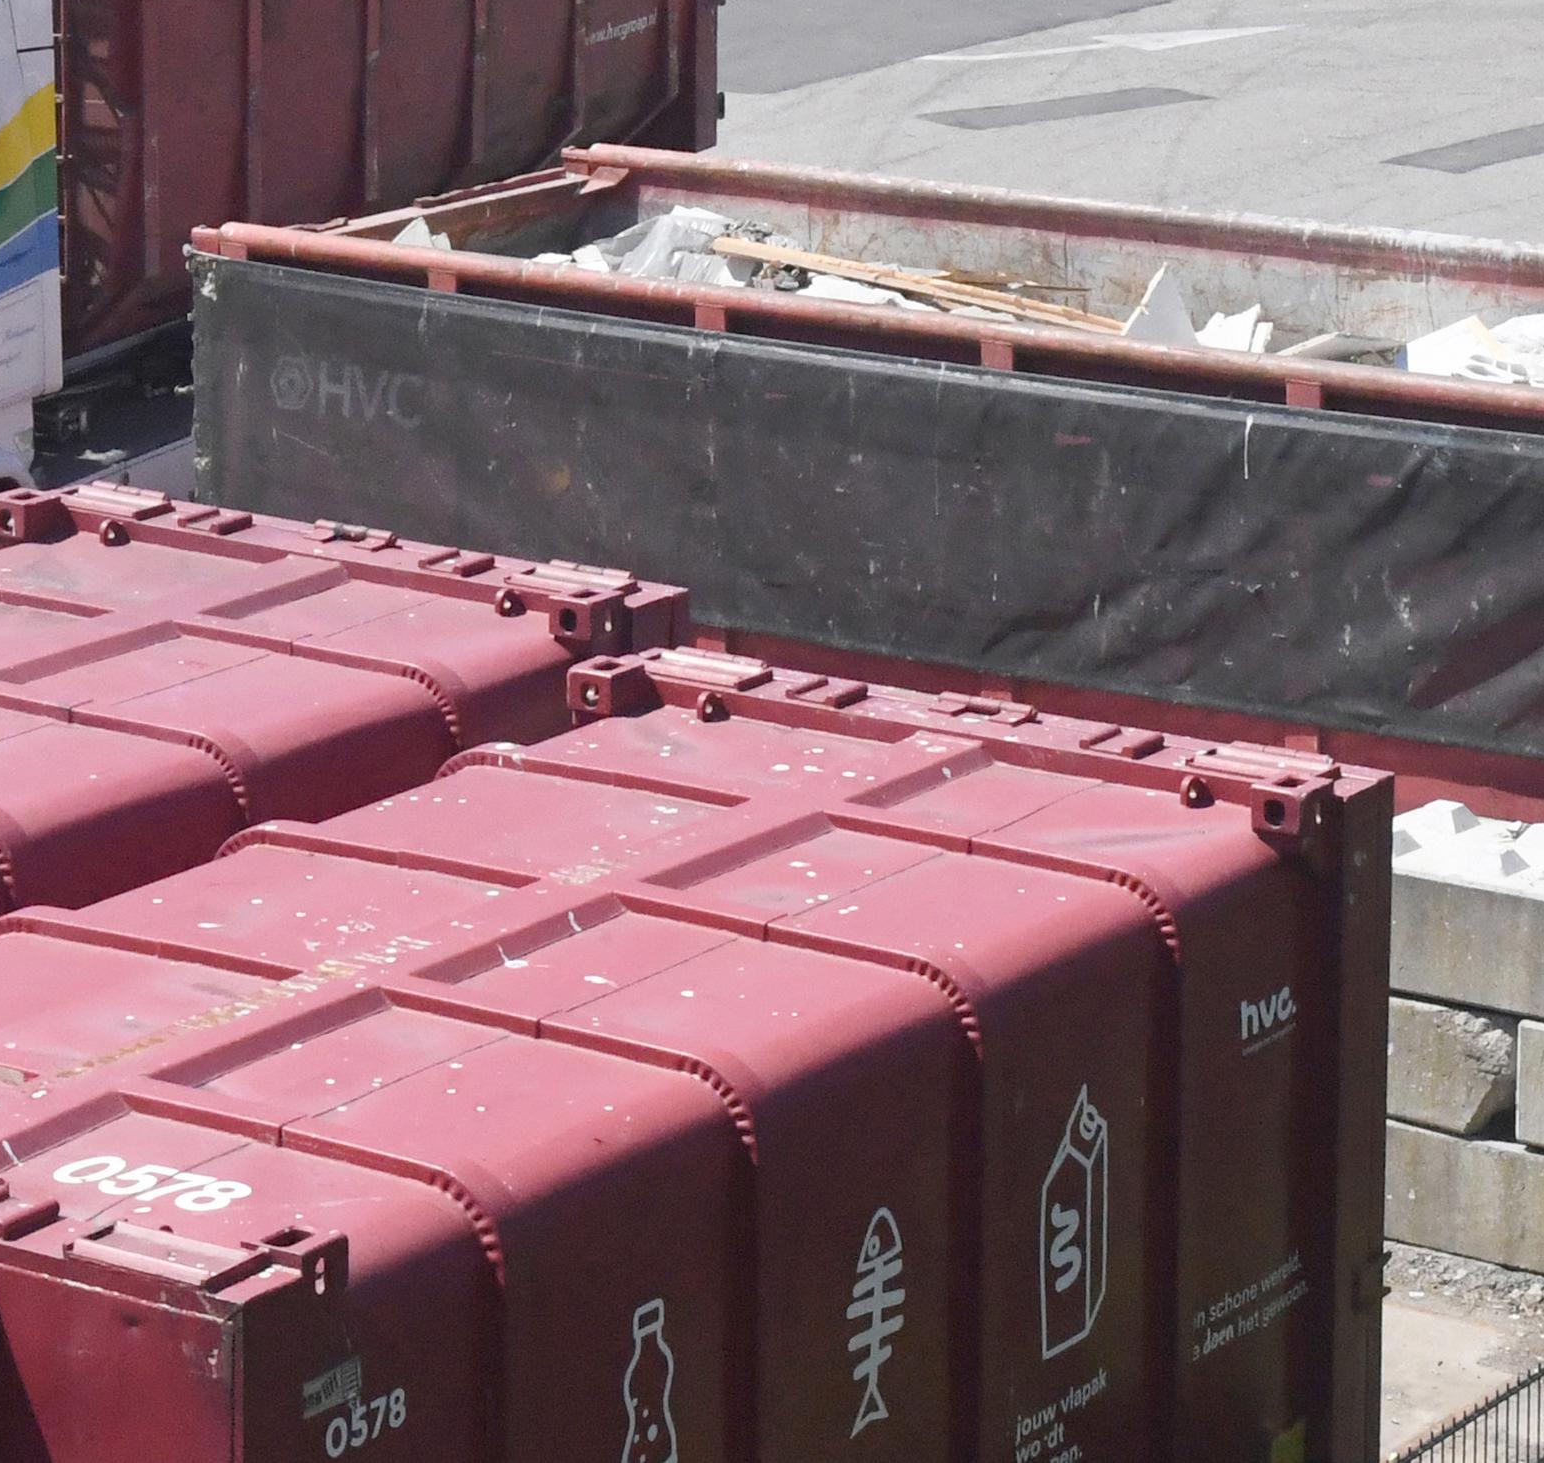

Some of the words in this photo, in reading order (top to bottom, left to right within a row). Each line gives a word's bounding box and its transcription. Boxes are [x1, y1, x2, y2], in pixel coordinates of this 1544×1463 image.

[318, 360, 426, 431] HVC
[1240, 985, 1297, 1041] hvc.
[52, 1155, 253, 1213] 0578
[1208, 1283, 1258, 1322] schone
[1237, 1309, 1259, 1337] het
[325, 1387, 407, 1458] 0578
[1015, 1414, 1057, 1447] jouw
[1060, 1367, 1108, 1414] vlapak
[1015, 1422, 1065, 1463] wodt
